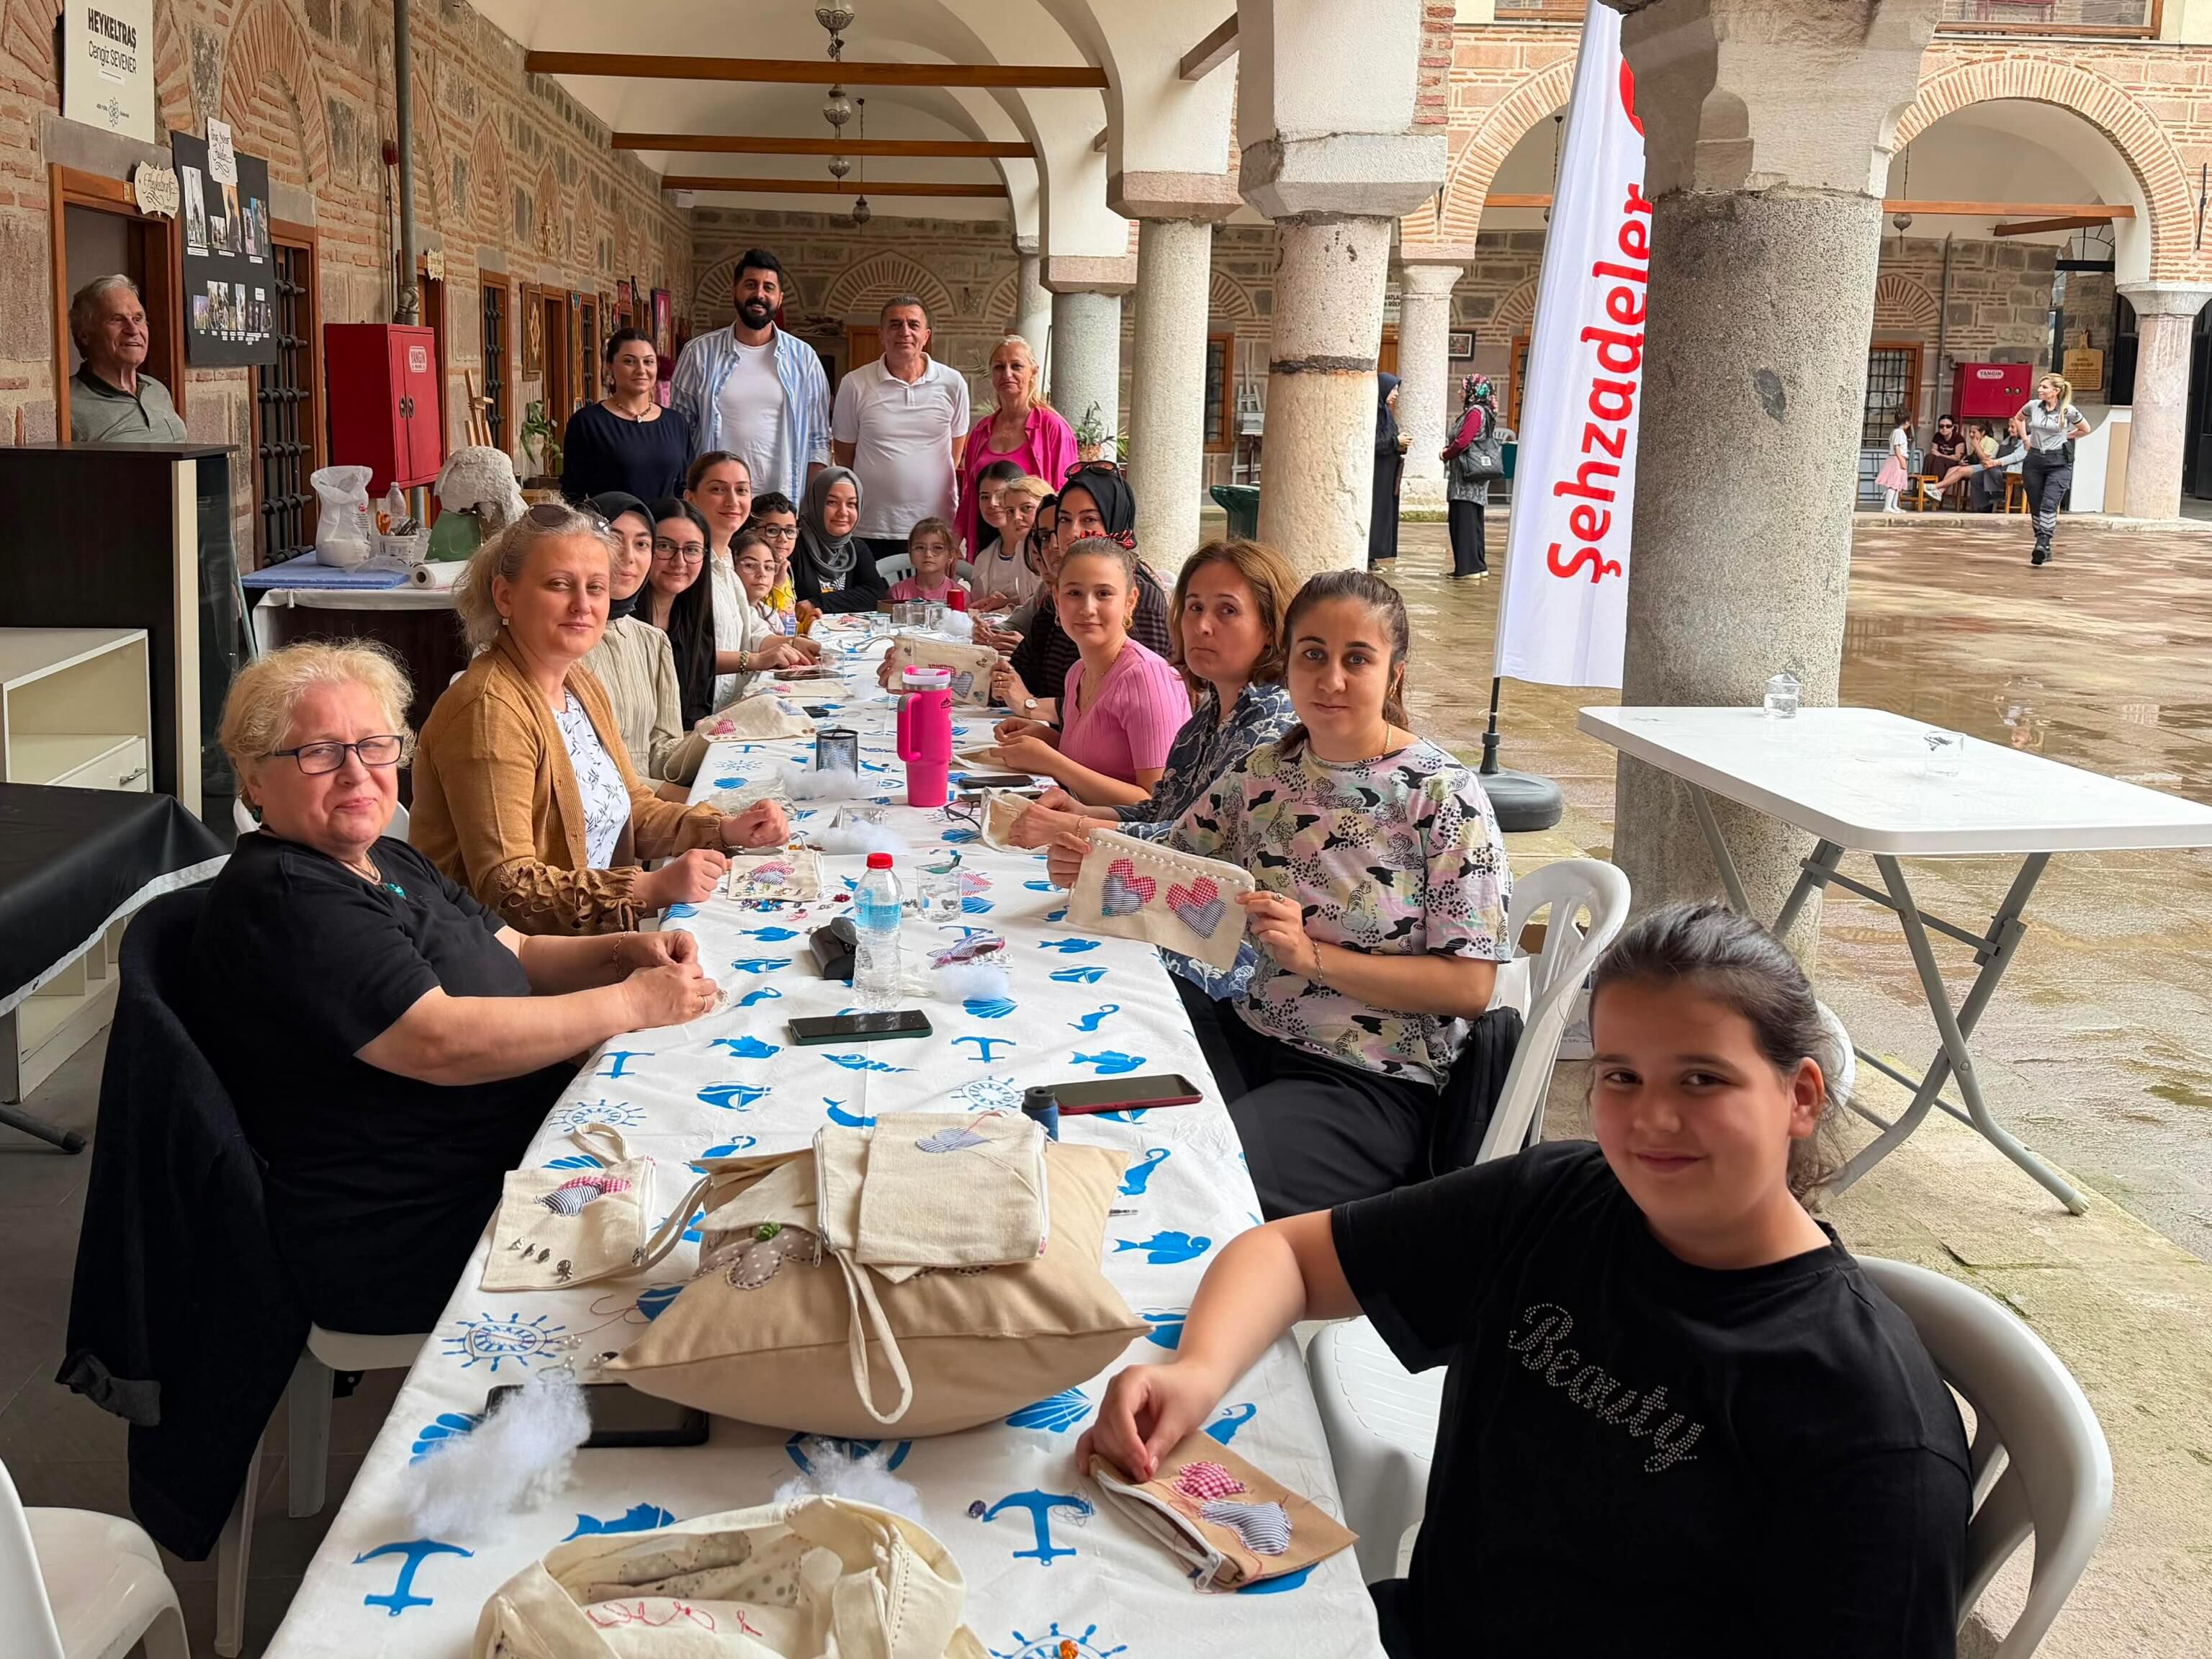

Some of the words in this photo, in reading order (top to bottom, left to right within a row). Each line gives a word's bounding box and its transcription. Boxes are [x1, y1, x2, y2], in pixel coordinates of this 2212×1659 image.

[88, 7, 136, 53] HEYKELTRAŞ
[89, 40, 109, 66] Cengiz
[110, 49, 137, 75] SEVENER
[1547, 182, 1653, 585] Şehzadeler
[1508, 1303, 1705, 1473] Beauty
